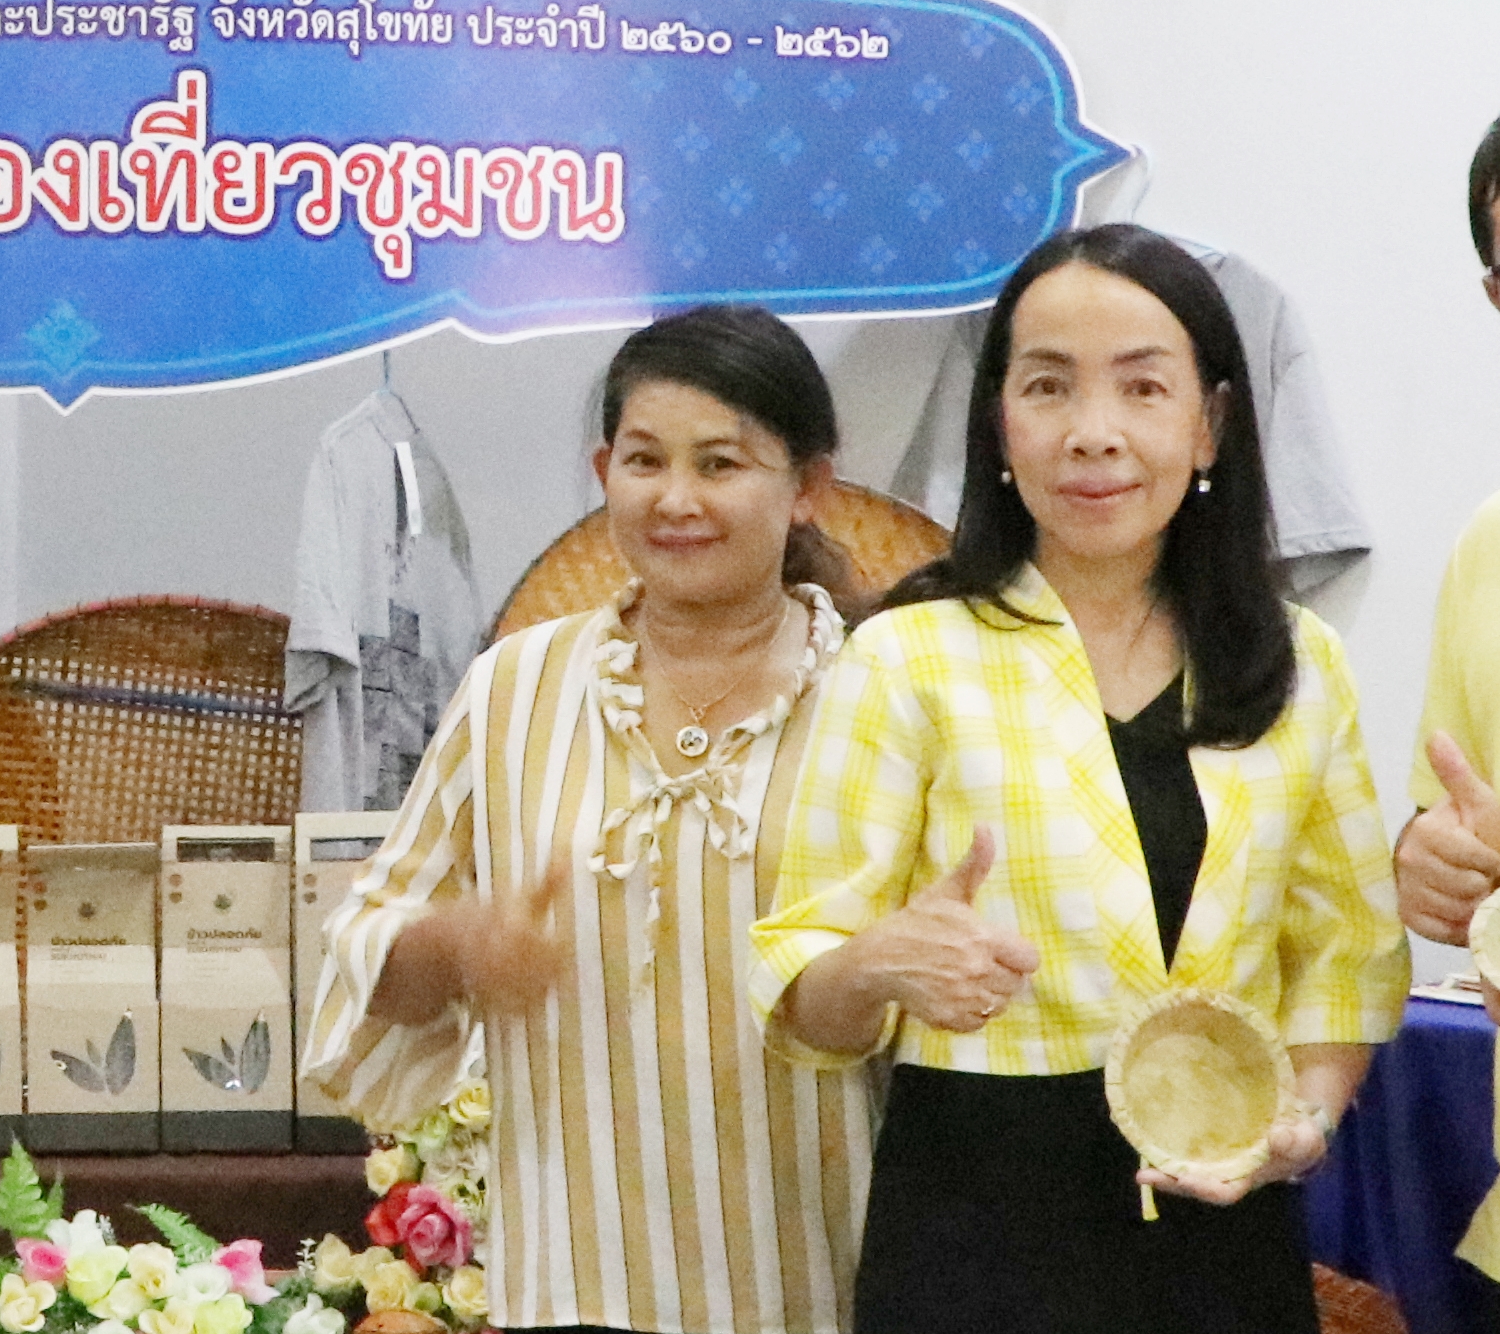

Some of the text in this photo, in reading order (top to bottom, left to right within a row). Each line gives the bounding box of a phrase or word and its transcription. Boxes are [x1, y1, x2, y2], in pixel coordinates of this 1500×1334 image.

[466, 5, 607, 51] ประจำปี
[620, 14, 732, 56] ๒๕๖๐
[776, 19, 889, 60] ๒๕๖๒
